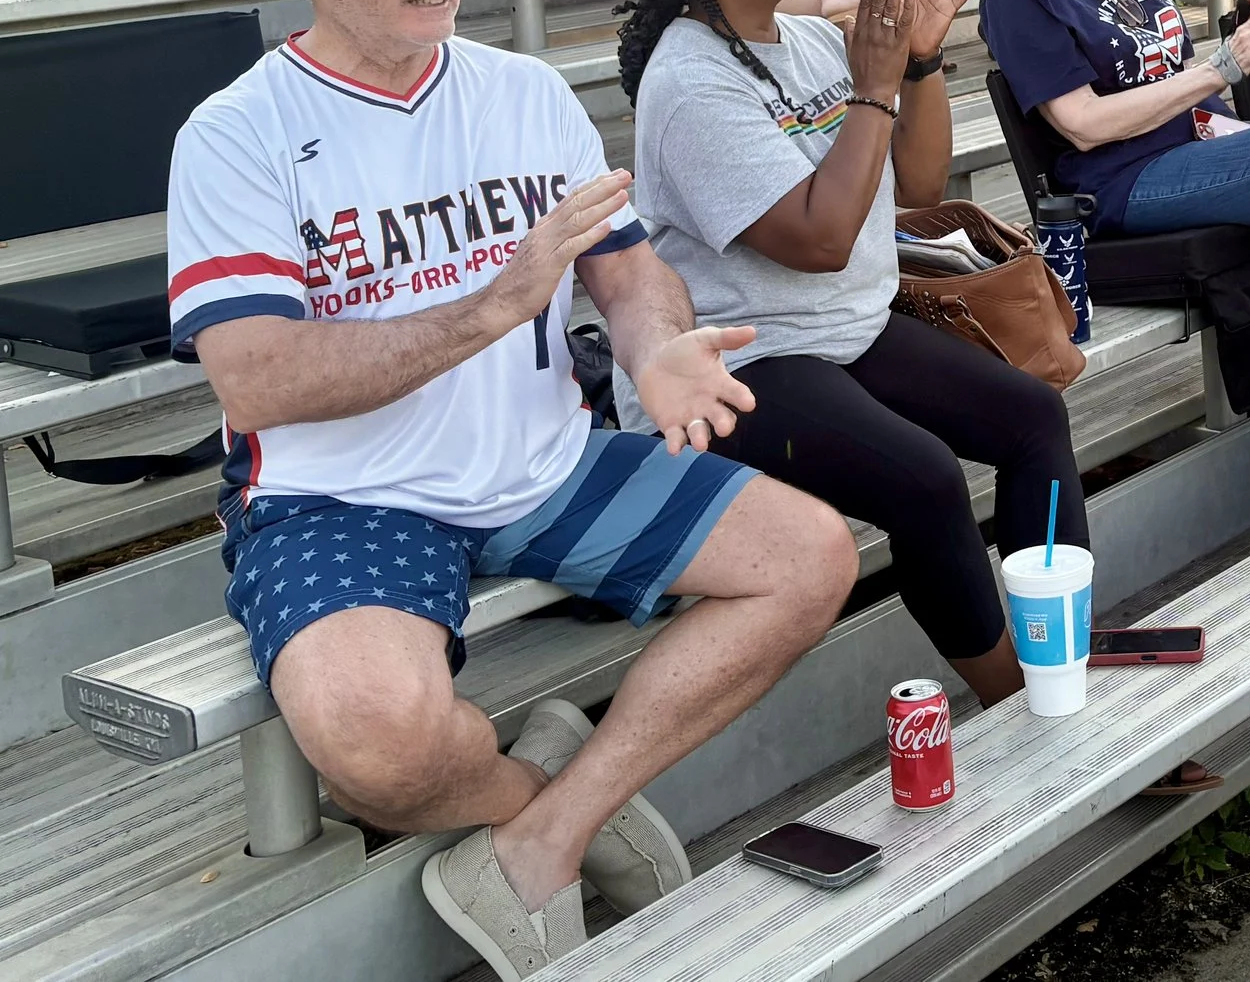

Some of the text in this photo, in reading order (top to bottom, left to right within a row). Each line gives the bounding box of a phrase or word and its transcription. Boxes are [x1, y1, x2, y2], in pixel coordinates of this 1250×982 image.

[300, 173, 568, 290] MATTHEWS
[309, 239, 525, 319] HOOKS-ORR POS
[904, 752, 925, 760] TASTE
